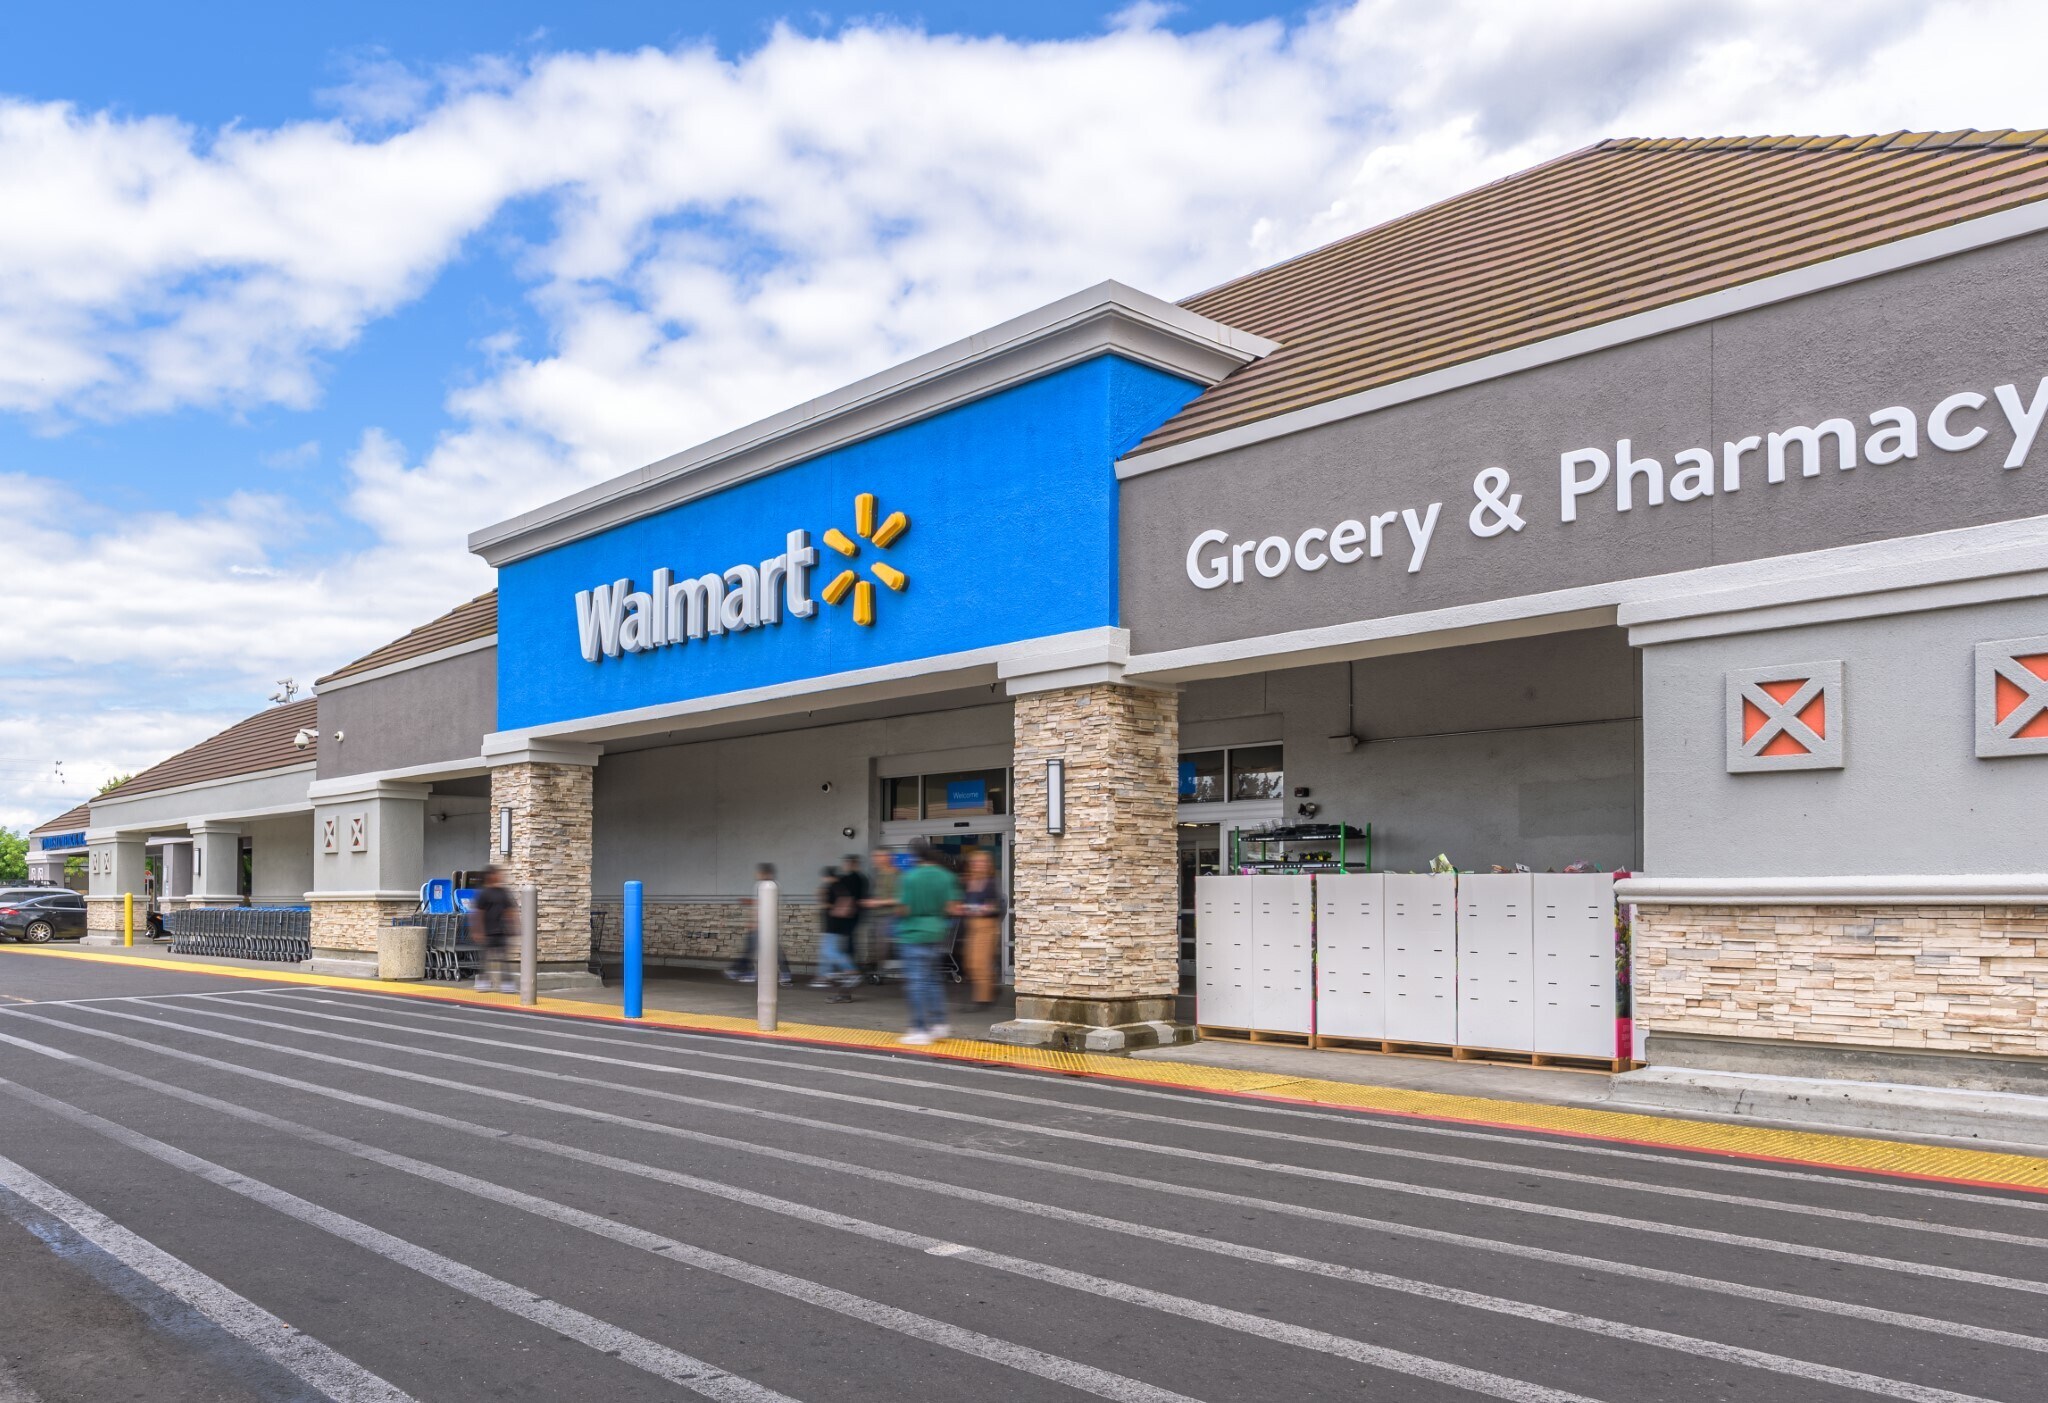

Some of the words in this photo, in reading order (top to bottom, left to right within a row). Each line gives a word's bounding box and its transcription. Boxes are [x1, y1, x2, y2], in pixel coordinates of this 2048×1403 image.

[1186, 501, 1442, 590] Grocery
[1468, 466, 1527, 539] &
[1560, 375, 2048, 523] Pharmacy
[575, 528, 819, 662] Walmart
[952, 791, 979, 799] Welcome
